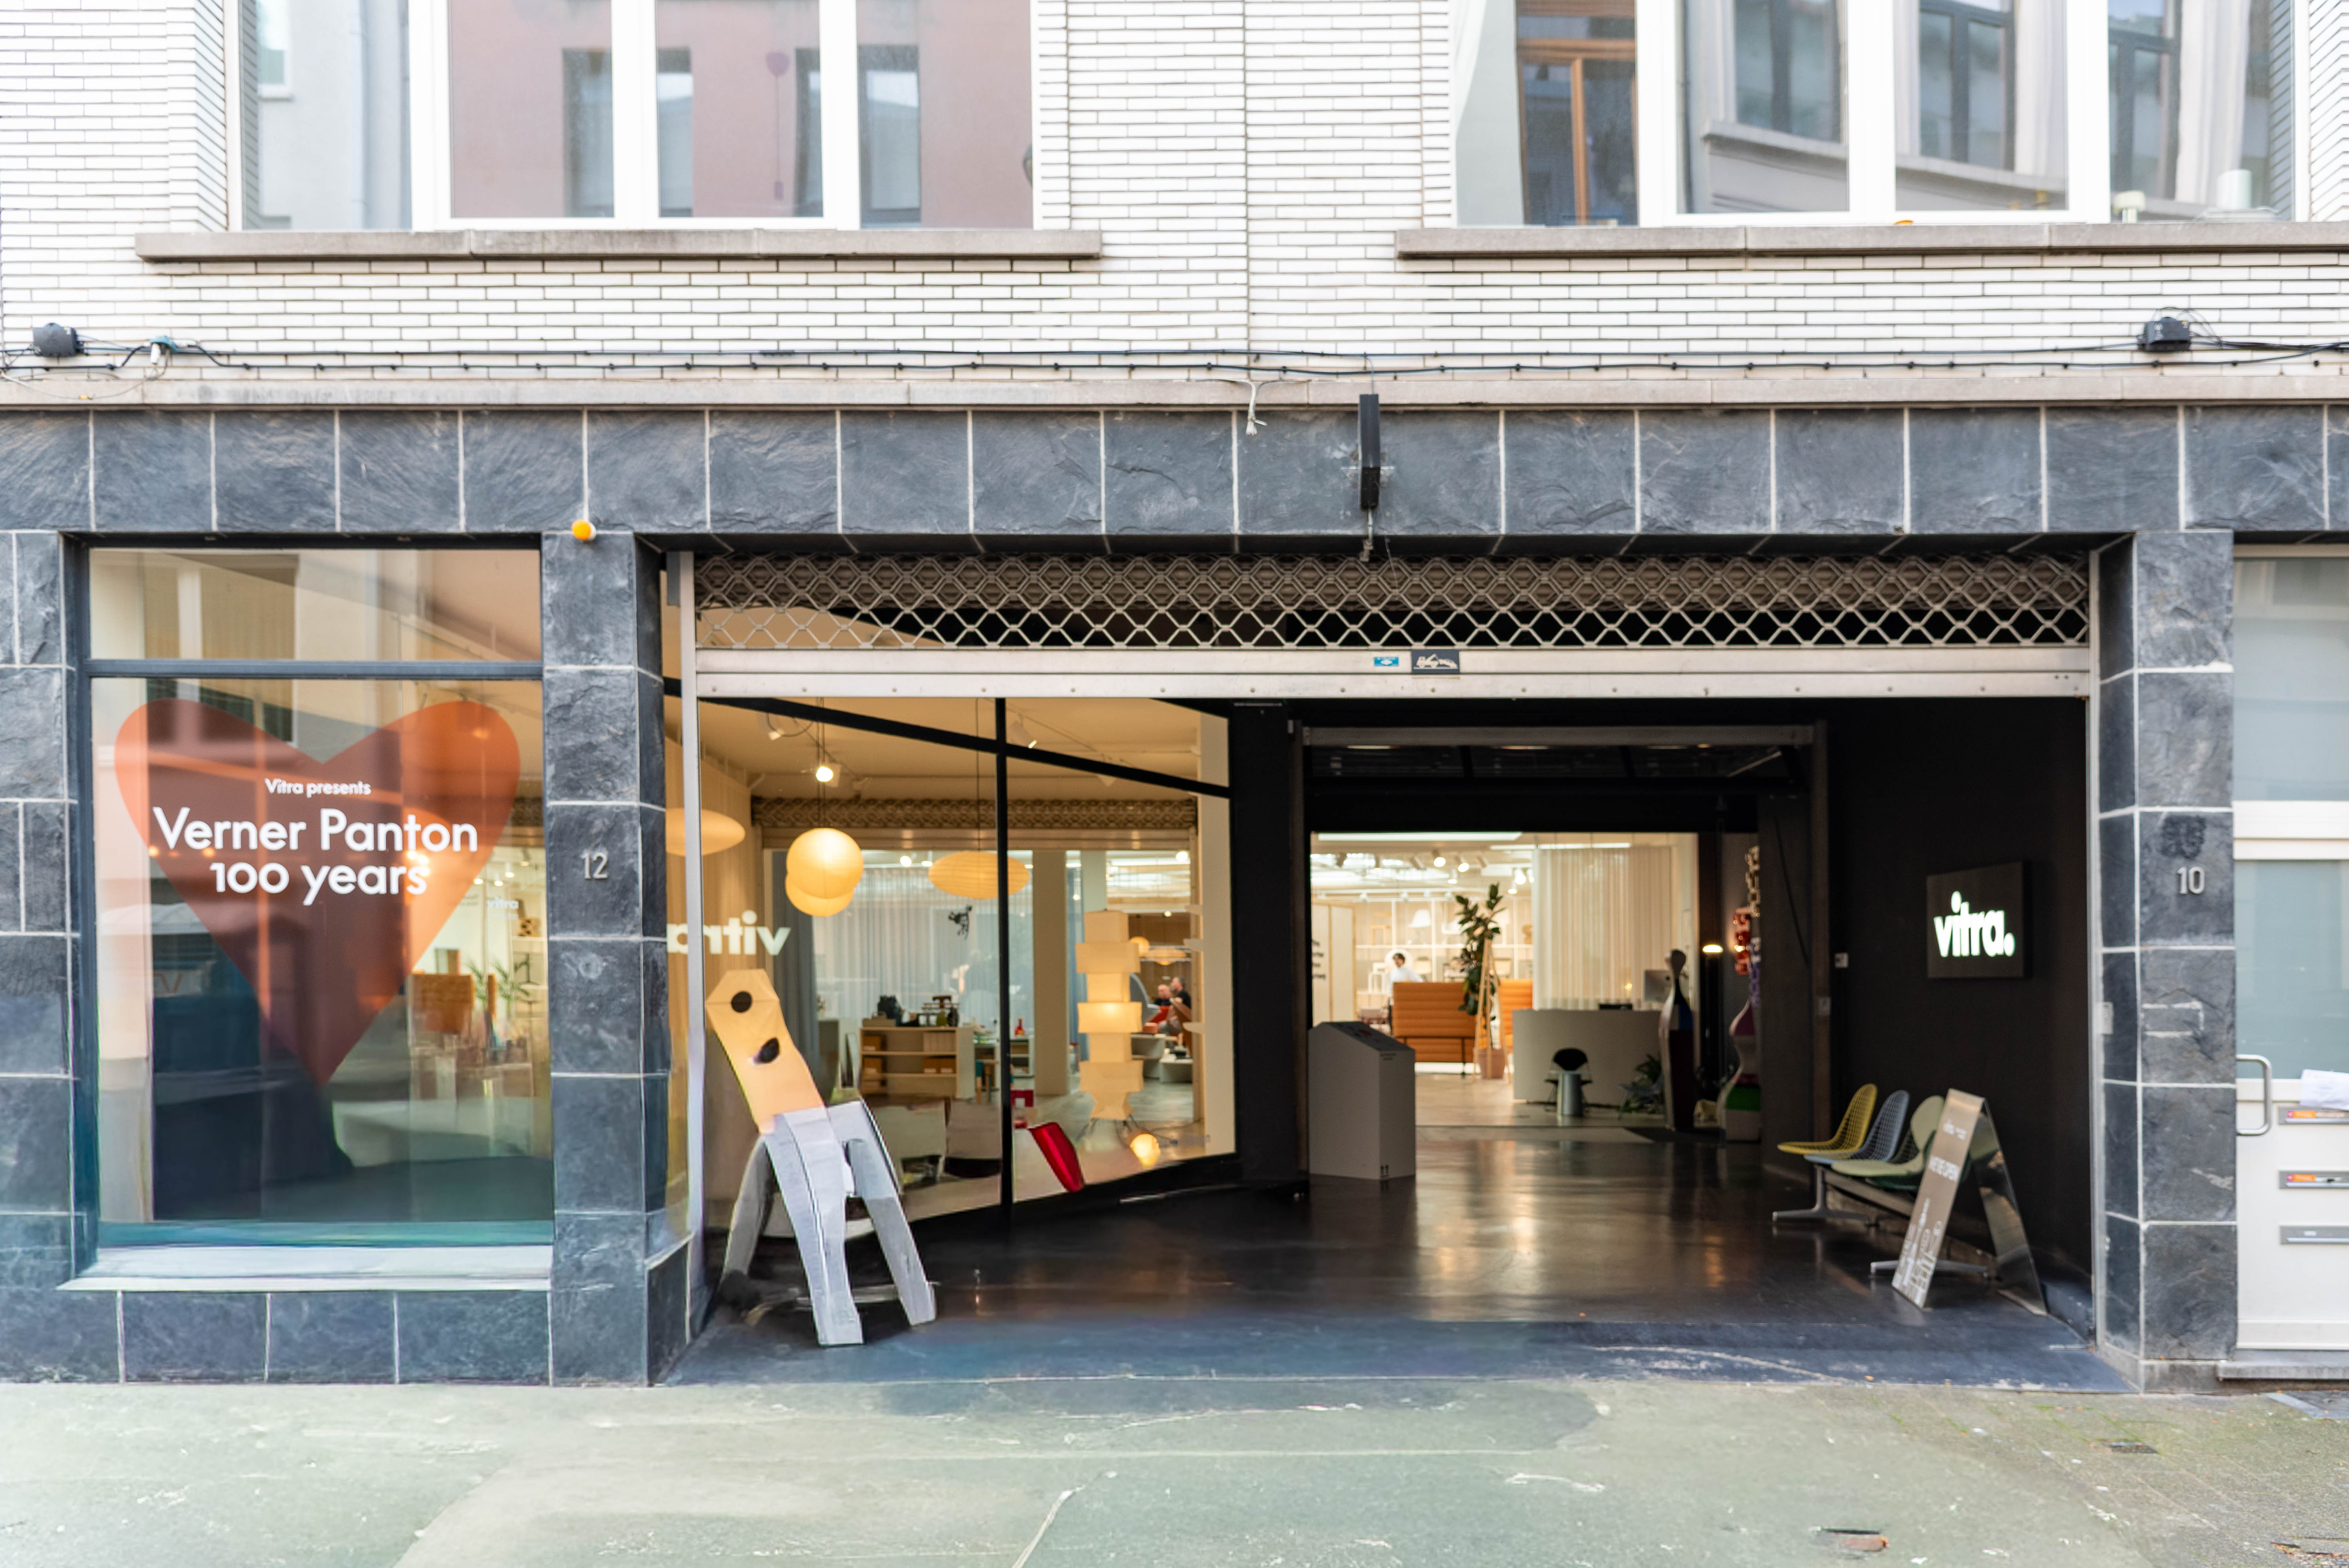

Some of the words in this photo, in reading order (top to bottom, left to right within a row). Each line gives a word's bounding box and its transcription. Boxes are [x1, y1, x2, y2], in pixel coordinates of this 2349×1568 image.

[264, 778, 304, 794] Vitra
[306, 780, 371, 798] presents
[152, 807, 306, 851] Verner
[320, 808, 478, 852] Panton
[581, 851, 608, 879] 12
[209, 862, 290, 894] 100
[301, 865, 427, 906] years
[2177, 866, 2205, 895] 10
